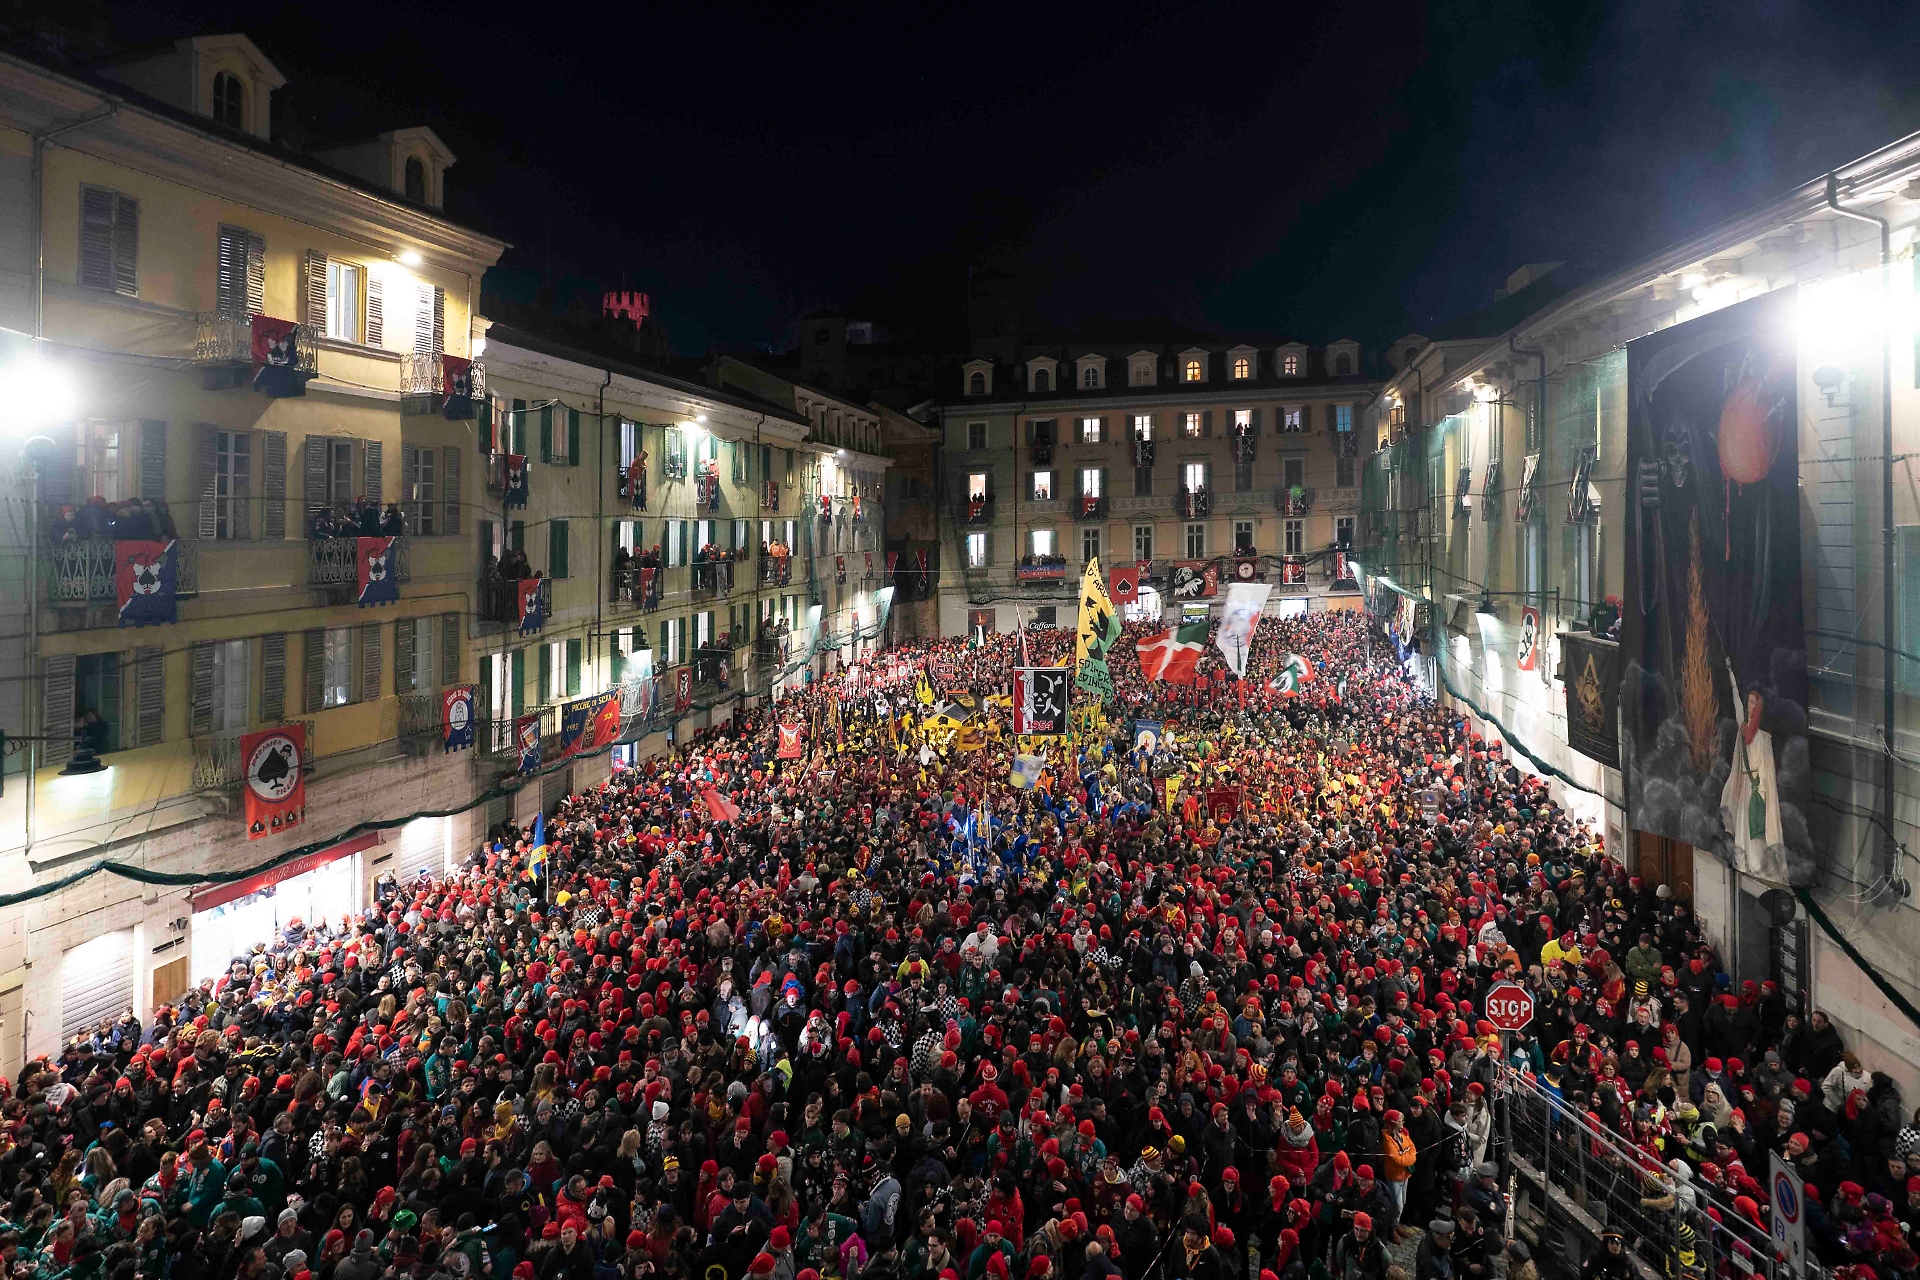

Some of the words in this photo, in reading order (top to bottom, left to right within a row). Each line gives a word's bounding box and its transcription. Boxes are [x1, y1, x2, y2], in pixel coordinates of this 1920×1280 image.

[1029, 621, 1056, 631] Caffaro
[1026, 720, 1053, 730] 1954
[1489, 998, 1530, 1017] STOP
